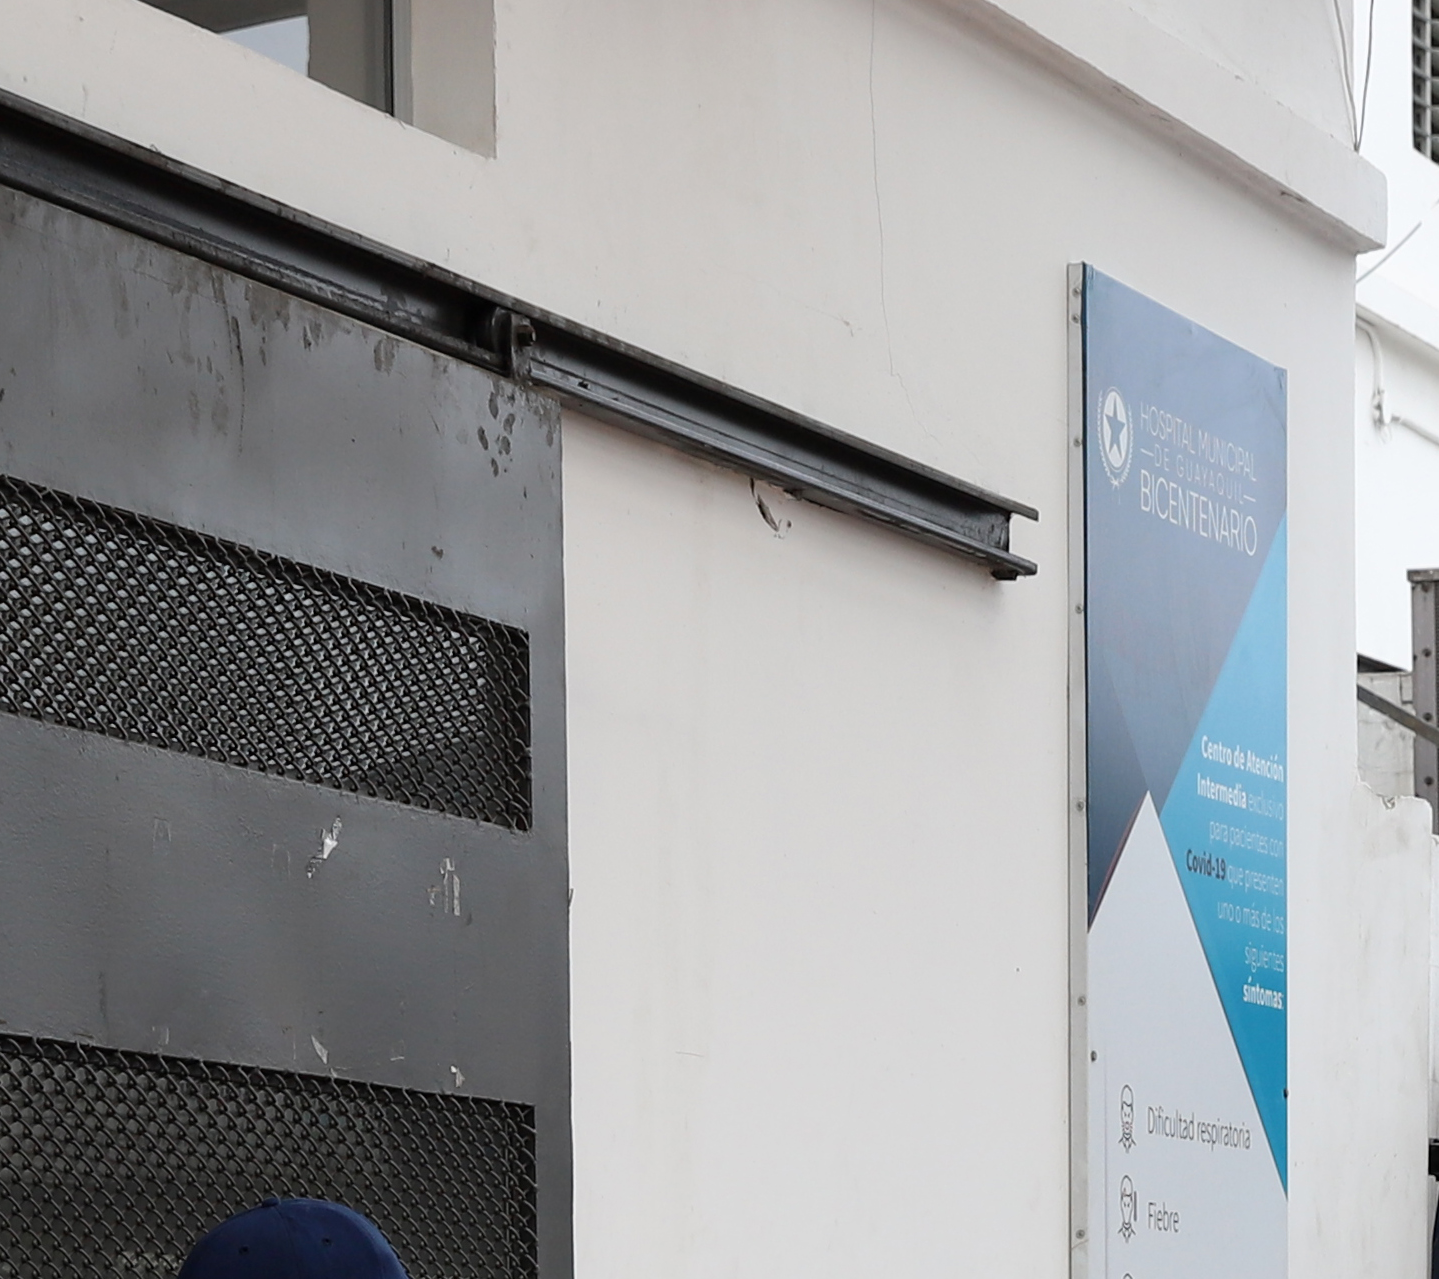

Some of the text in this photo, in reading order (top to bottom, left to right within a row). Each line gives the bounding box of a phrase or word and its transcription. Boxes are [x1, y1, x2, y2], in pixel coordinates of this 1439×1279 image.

[1141, 402, 1256, 482] HOSPITAL MUNICIPAL
[1141, 469, 1257, 556] BICENTENARIO
[1201, 735, 1284, 782] Centro de Atención
[1197, 773, 1246, 809] Intermedia
[1186, 849, 1226, 880] Covid-19
[1147, 1106, 1251, 1152] Dificultad respiratoria
[1148, 1202, 1179, 1232] Fiebre
